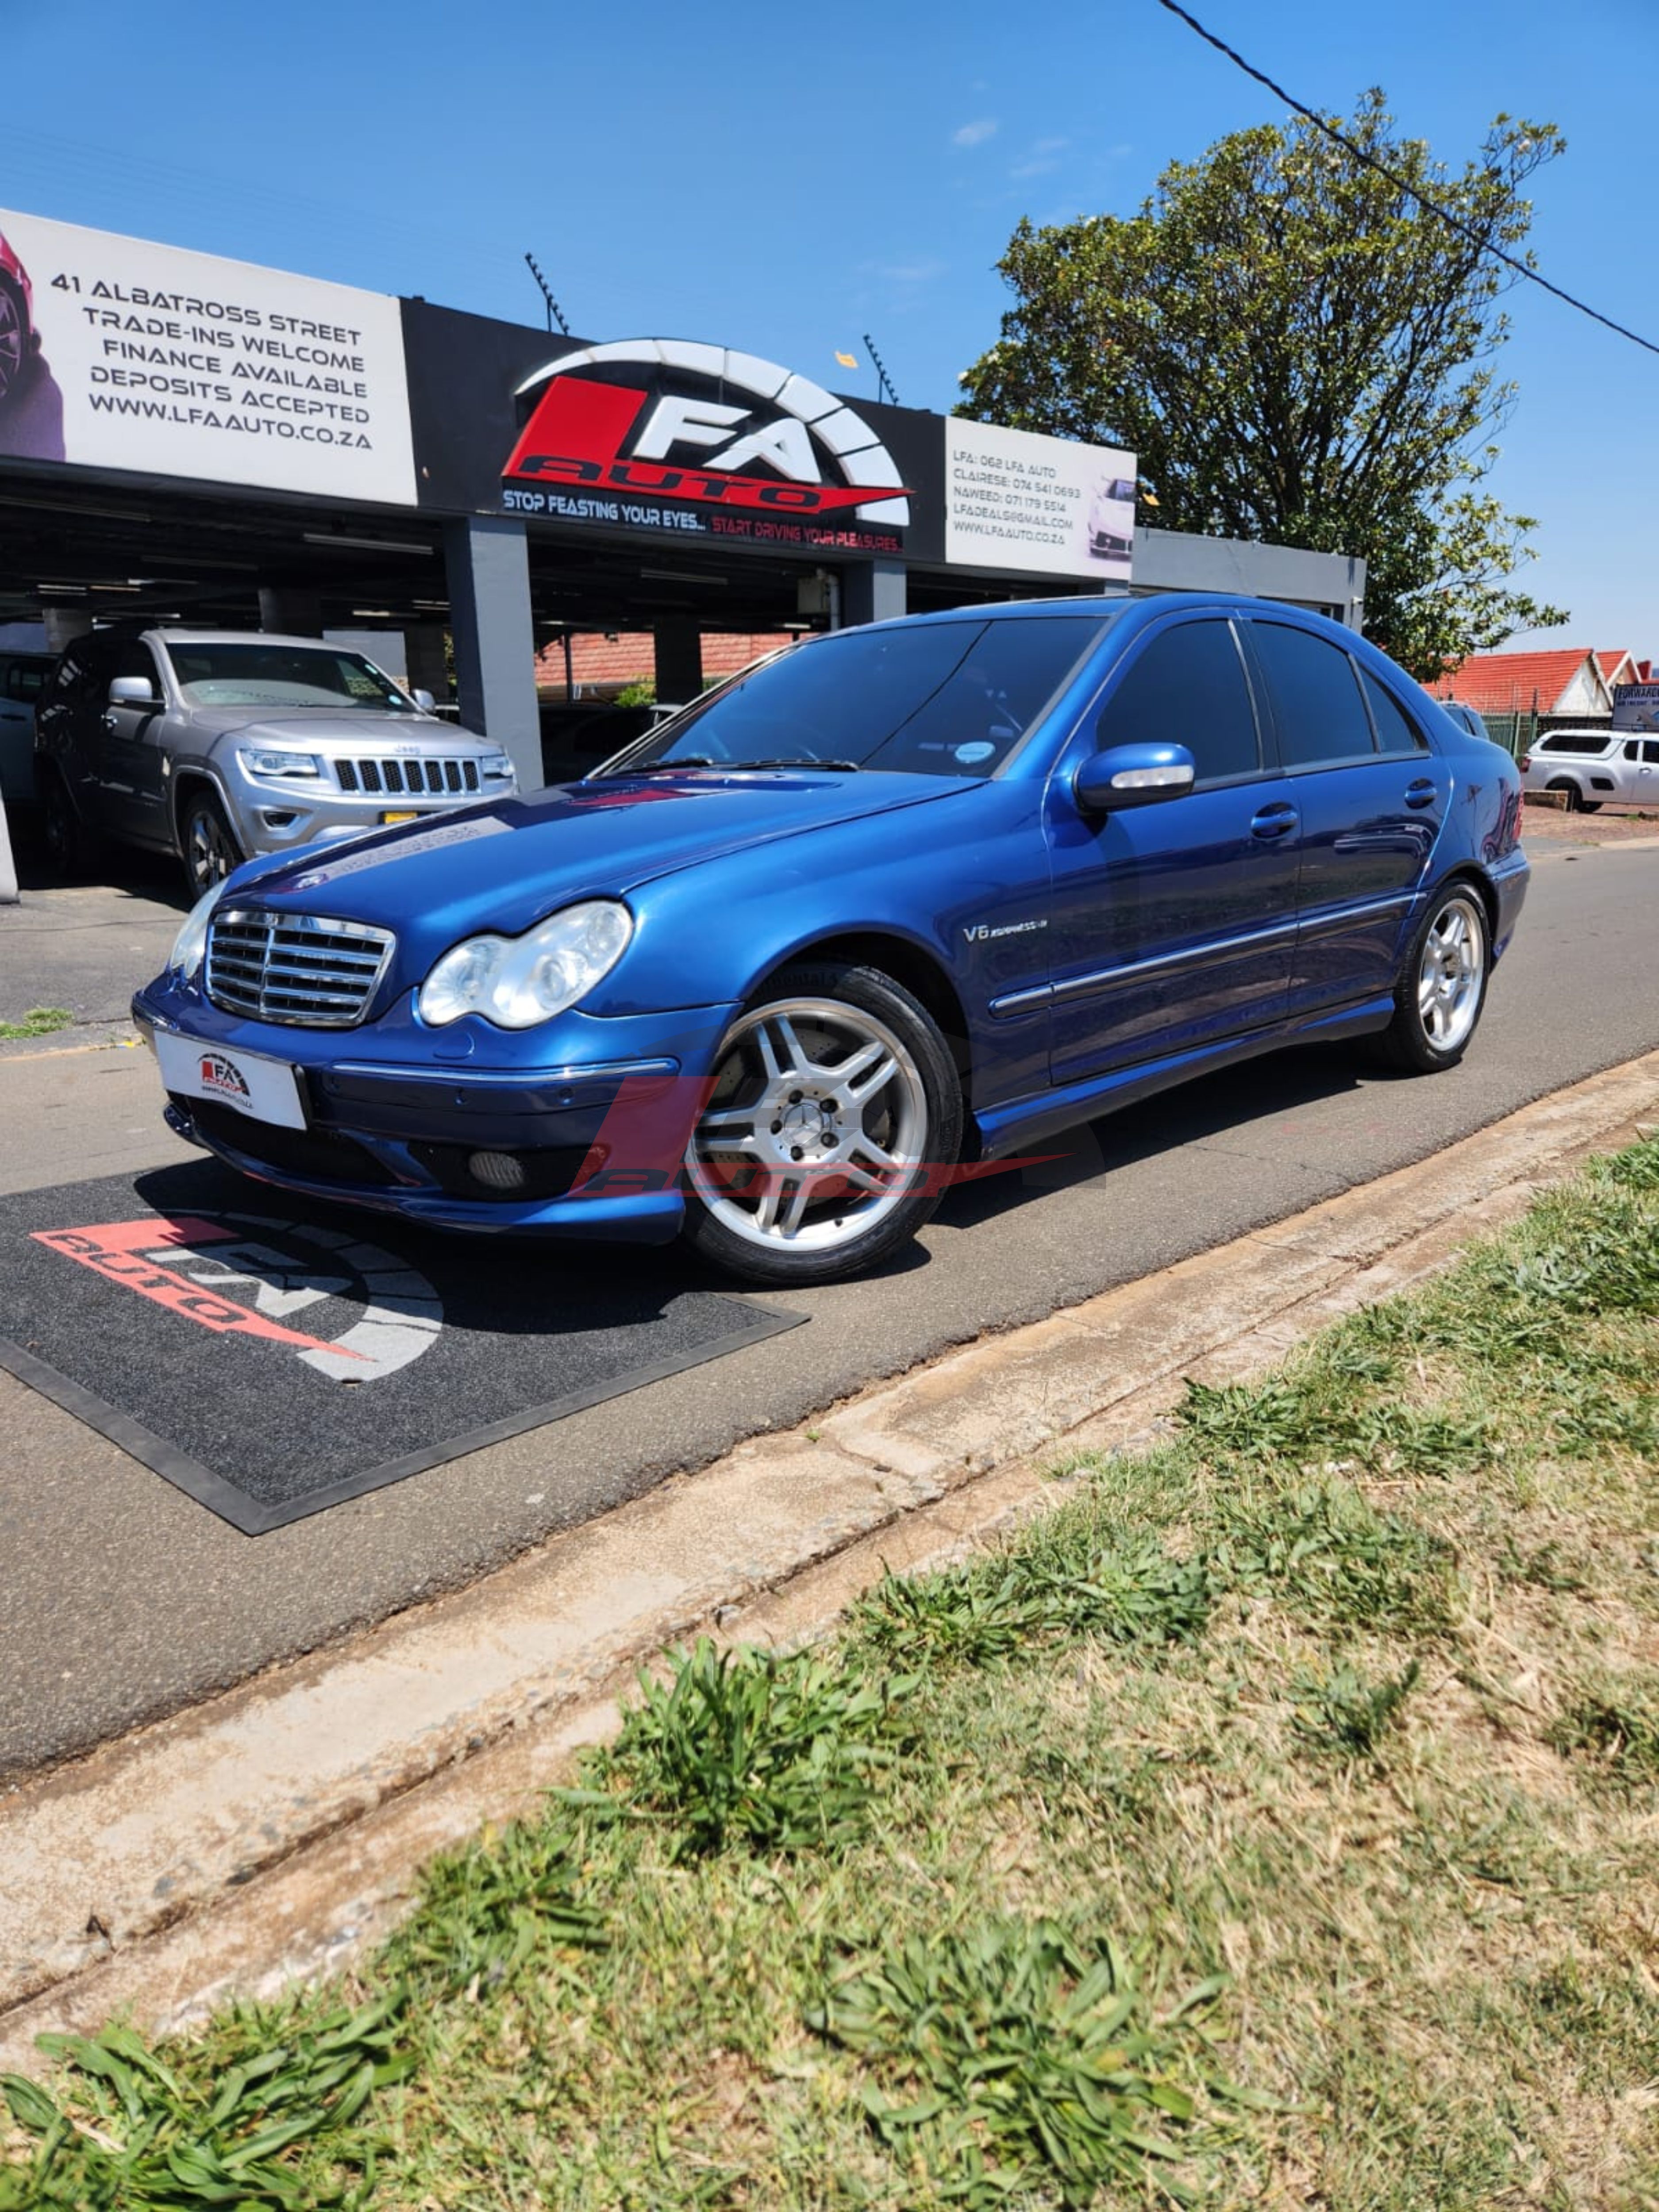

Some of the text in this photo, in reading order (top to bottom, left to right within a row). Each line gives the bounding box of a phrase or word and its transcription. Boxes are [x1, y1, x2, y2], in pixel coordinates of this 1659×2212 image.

[51, 273, 362, 346] 41 ALBATROSS STREET
[83, 308, 365, 373] TRADE-INS WELCOME
[91, 366, 370, 424] DEPOSITS ACCEPTED
[103, 339, 367, 399] FINANCE AVAILABLE
[89, 394, 373, 450] WWW.LFAAUTO.CO.ZA
[519, 456, 822, 508] AUTO
[953, 450, 1056, 479] LFA: 062 LFA AUTO
[954, 468, 1010, 488] CLAIRESE:
[503, 489, 547, 511] STOP
[548, 495, 619, 520] FEASTING
[620, 503, 660, 525] YOUR
[663, 510, 706, 531] EYES...
[712, 517, 752, 535] START
[754, 522, 801, 542] DRIVING
[804, 528, 834, 545] YOUR
[954, 486, 1003, 503] NAWEED:
[954, 521, 1066, 545] WWW.LFAAUTO.CO.ZA
[963, 924, 989, 942] V6
[44, 1233, 248, 1324] AUTO
